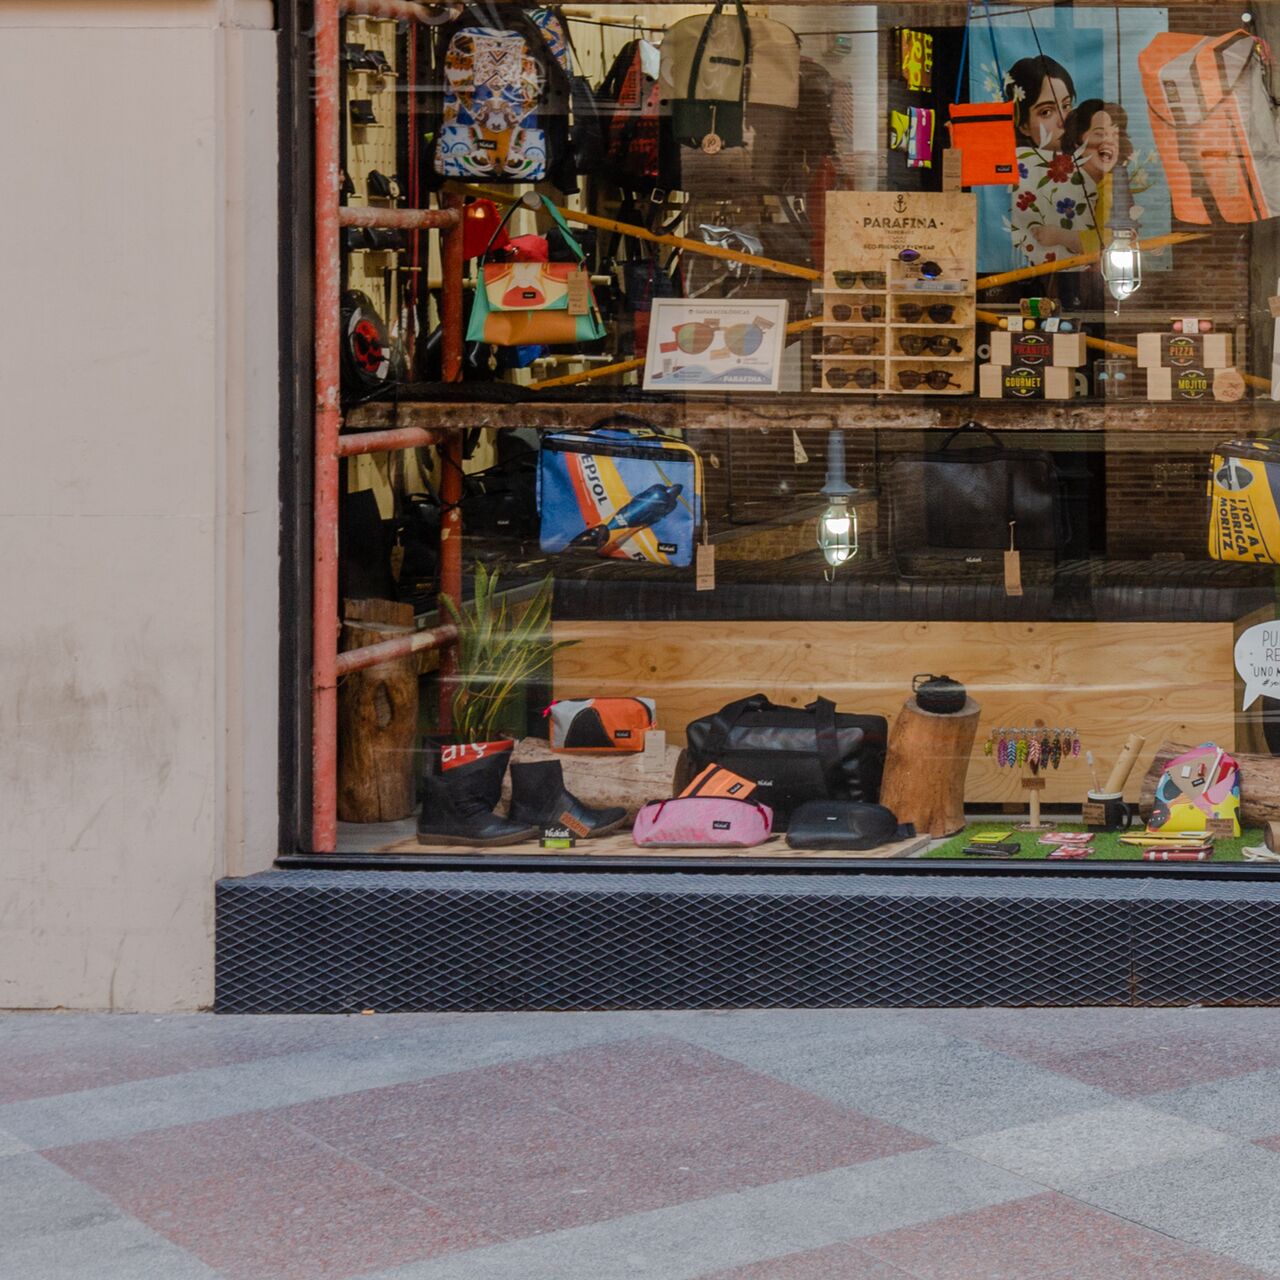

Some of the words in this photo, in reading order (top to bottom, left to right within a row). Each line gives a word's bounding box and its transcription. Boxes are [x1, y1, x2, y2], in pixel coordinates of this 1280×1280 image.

[863, 217, 937, 229] PARAFINA
[1169, 346, 1194, 356] PIZZA
[1005, 377, 1040, 387] GOURMET
[1178, 379, 1207, 389] MOJITO
[1219, 497, 1234, 551] MORITZ
